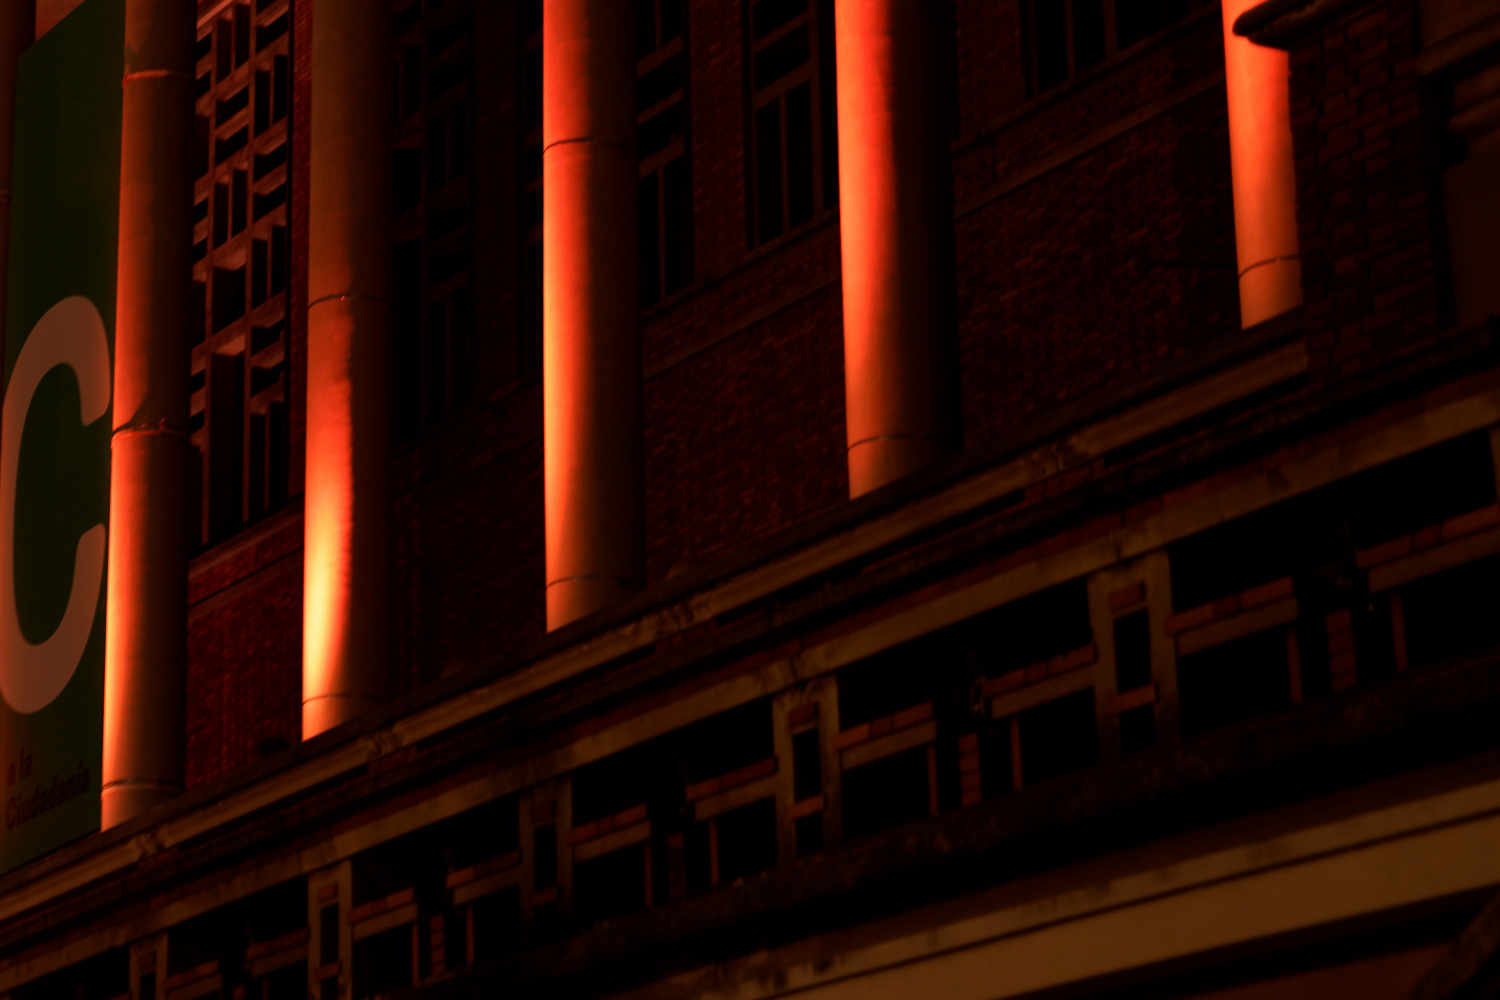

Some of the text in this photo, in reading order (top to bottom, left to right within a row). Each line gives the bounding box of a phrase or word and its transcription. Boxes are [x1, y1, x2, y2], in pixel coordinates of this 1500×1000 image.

[7, 747, 32, 786] a la
[6, 759, 90, 831] Ciudadanía
